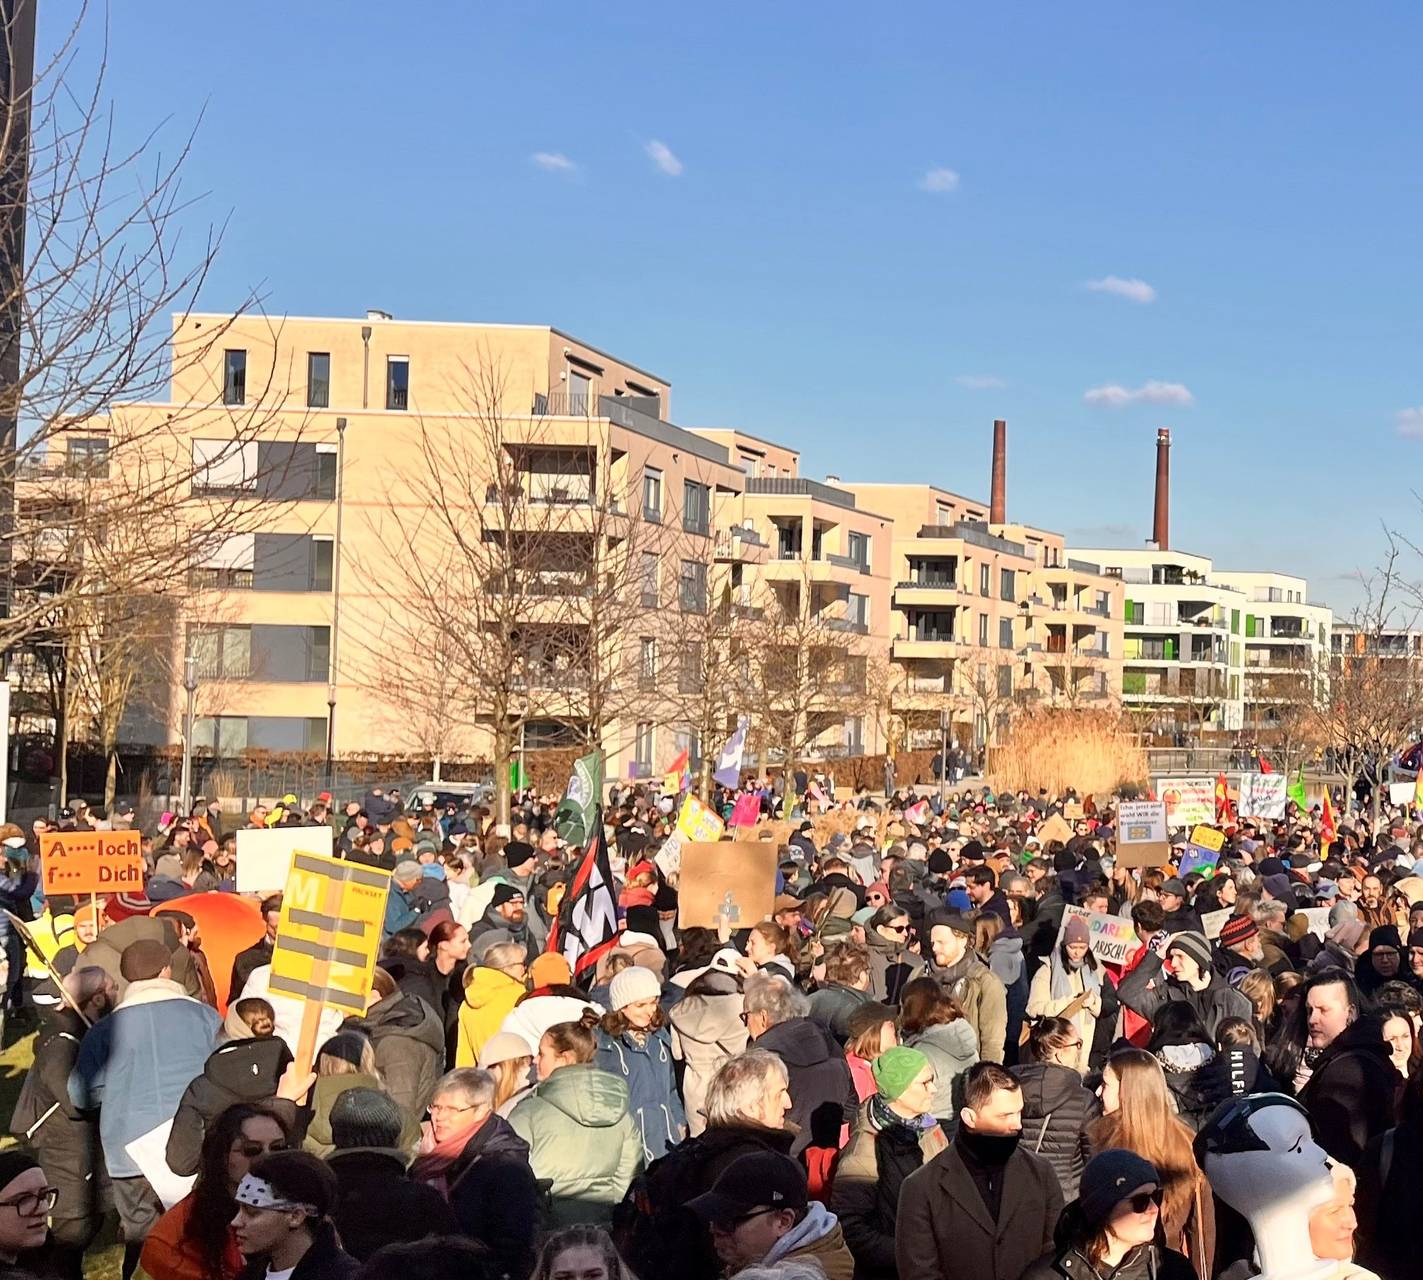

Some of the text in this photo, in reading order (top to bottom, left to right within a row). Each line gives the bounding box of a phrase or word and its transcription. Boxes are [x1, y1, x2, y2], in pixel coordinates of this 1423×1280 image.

[98, 863, 139, 882] Dich
[1093, 939, 1127, 961] ARISCH!
[1230, 1050, 1246, 1095] HILFI
